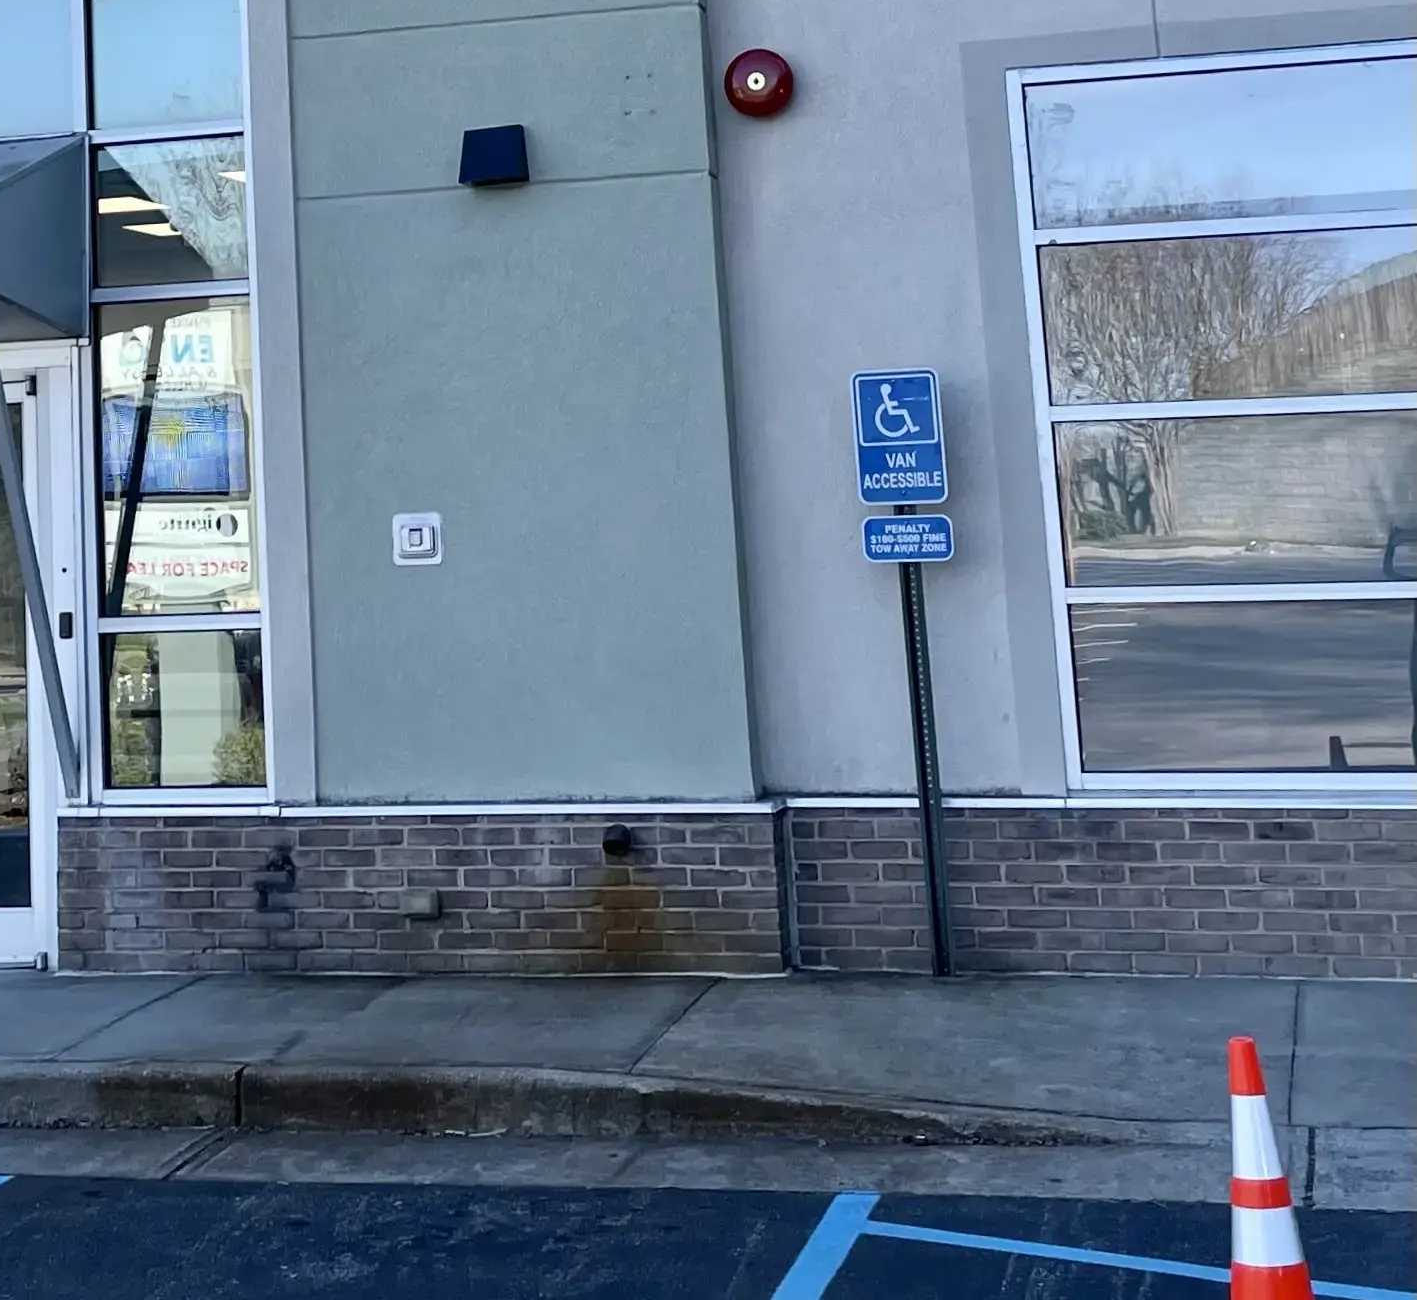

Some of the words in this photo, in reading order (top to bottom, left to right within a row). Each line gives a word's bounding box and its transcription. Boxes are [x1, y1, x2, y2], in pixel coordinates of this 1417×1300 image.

[885, 452, 916, 469] VAN
[863, 471, 942, 490] ACCESSIBLE
[884, 524, 930, 534] PENALTY
[922, 533, 946, 542] FINE
[870, 544, 891, 554] TOW
[893, 544, 919, 553] AWAY
[921, 543, 947, 553] ZONE
